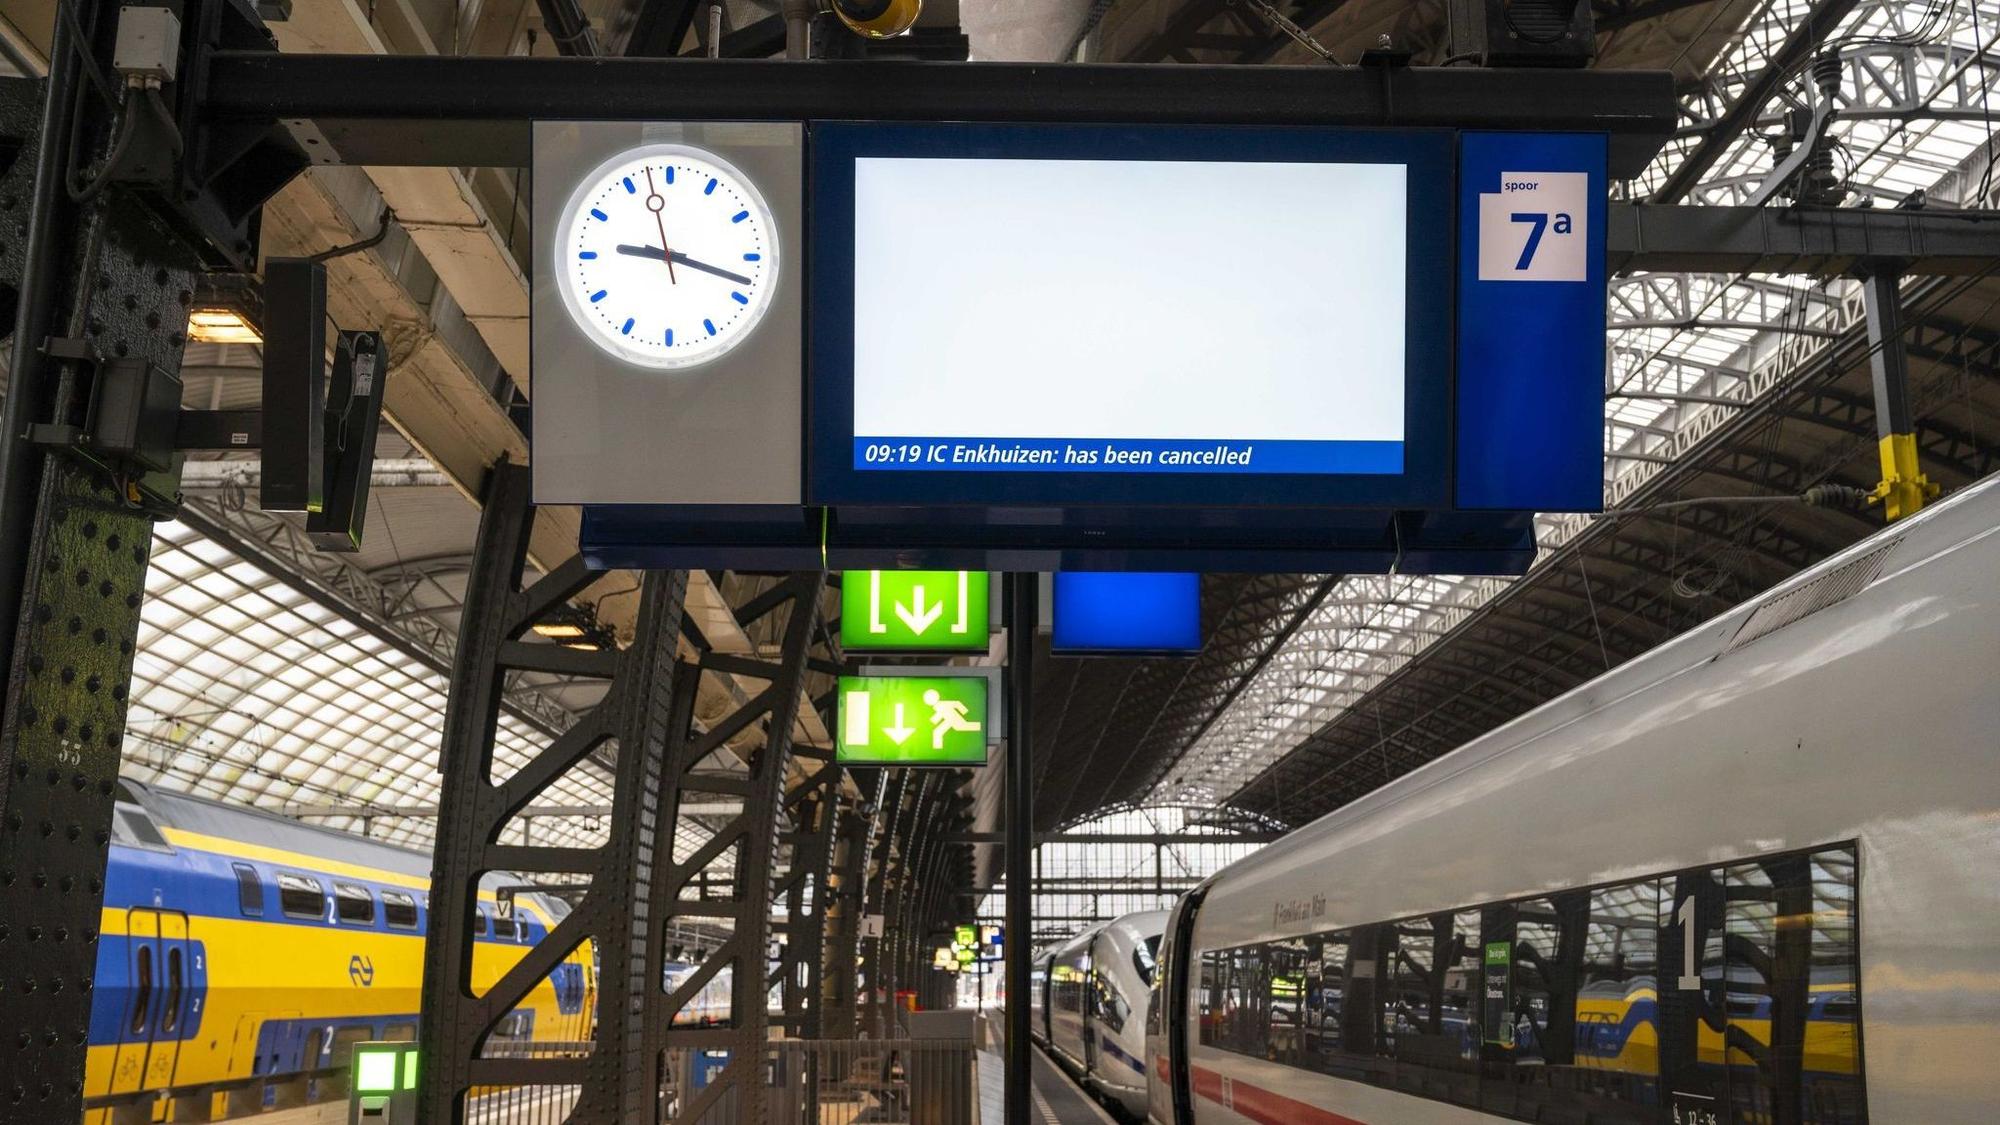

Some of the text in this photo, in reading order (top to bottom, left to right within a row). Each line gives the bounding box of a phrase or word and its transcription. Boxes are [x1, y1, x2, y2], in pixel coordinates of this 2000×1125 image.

[1505, 182, 1539, 192] spoor
[865, 444, 1253, 465] 09:19 IC Enkhuizen: has been cancelled
[327, 896, 336, 925] 2
[1678, 895, 1701, 990] 1
[196, 955, 202, 970] 2
[193, 998, 200, 1013] 2
[322, 1026, 334, 1054] 2
